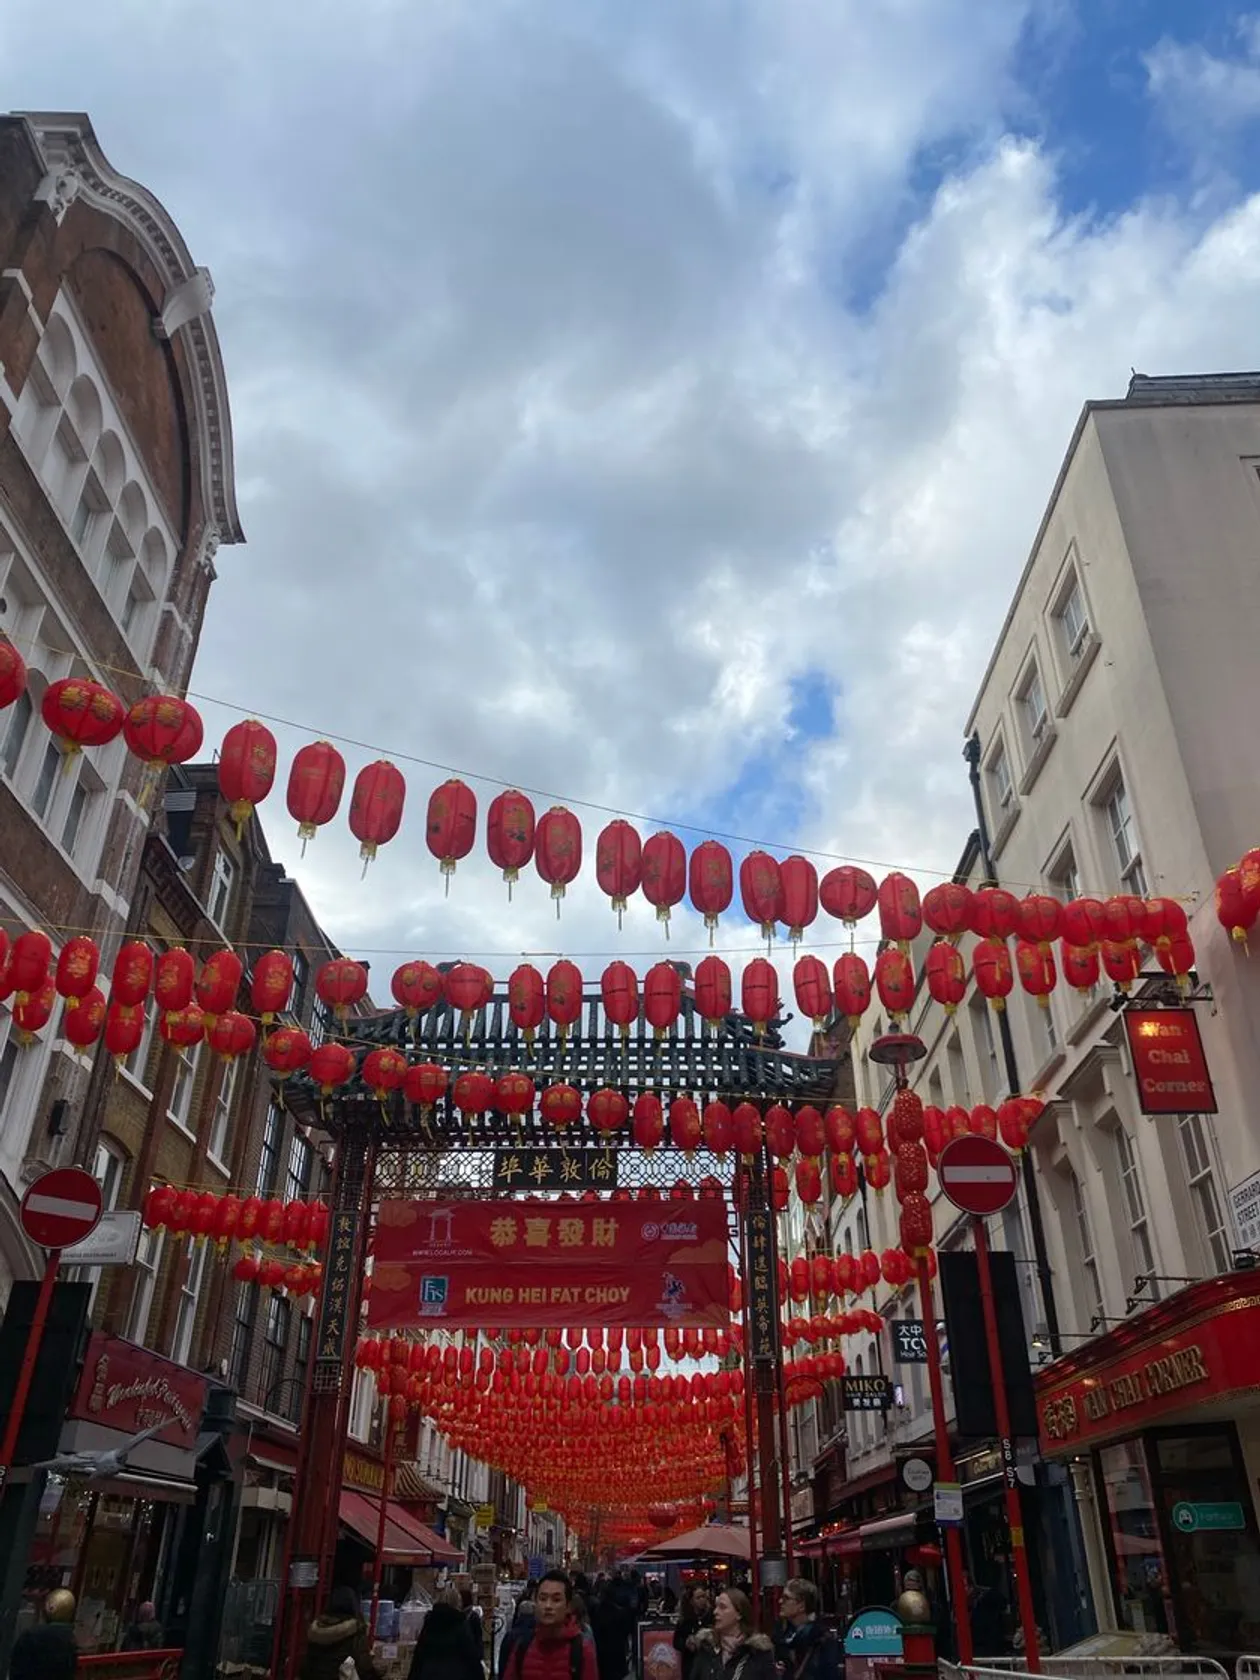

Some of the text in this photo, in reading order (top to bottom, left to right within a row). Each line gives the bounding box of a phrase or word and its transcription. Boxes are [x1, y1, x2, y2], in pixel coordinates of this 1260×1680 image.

[1148, 1048, 1191, 1064] Chai
[1143, 1077, 1206, 1093] Corner
[1237, 1201, 1259, 1226] STREET
[490, 1217, 619, 1247] 恭喜發財
[465, 1286, 631, 1304] KUNG HEI FAT CHOY
[898, 1324, 924, 1336] 大中
[1144, 1344, 1208, 1396] CORNER
[845, 1378, 886, 1392] MIKO
